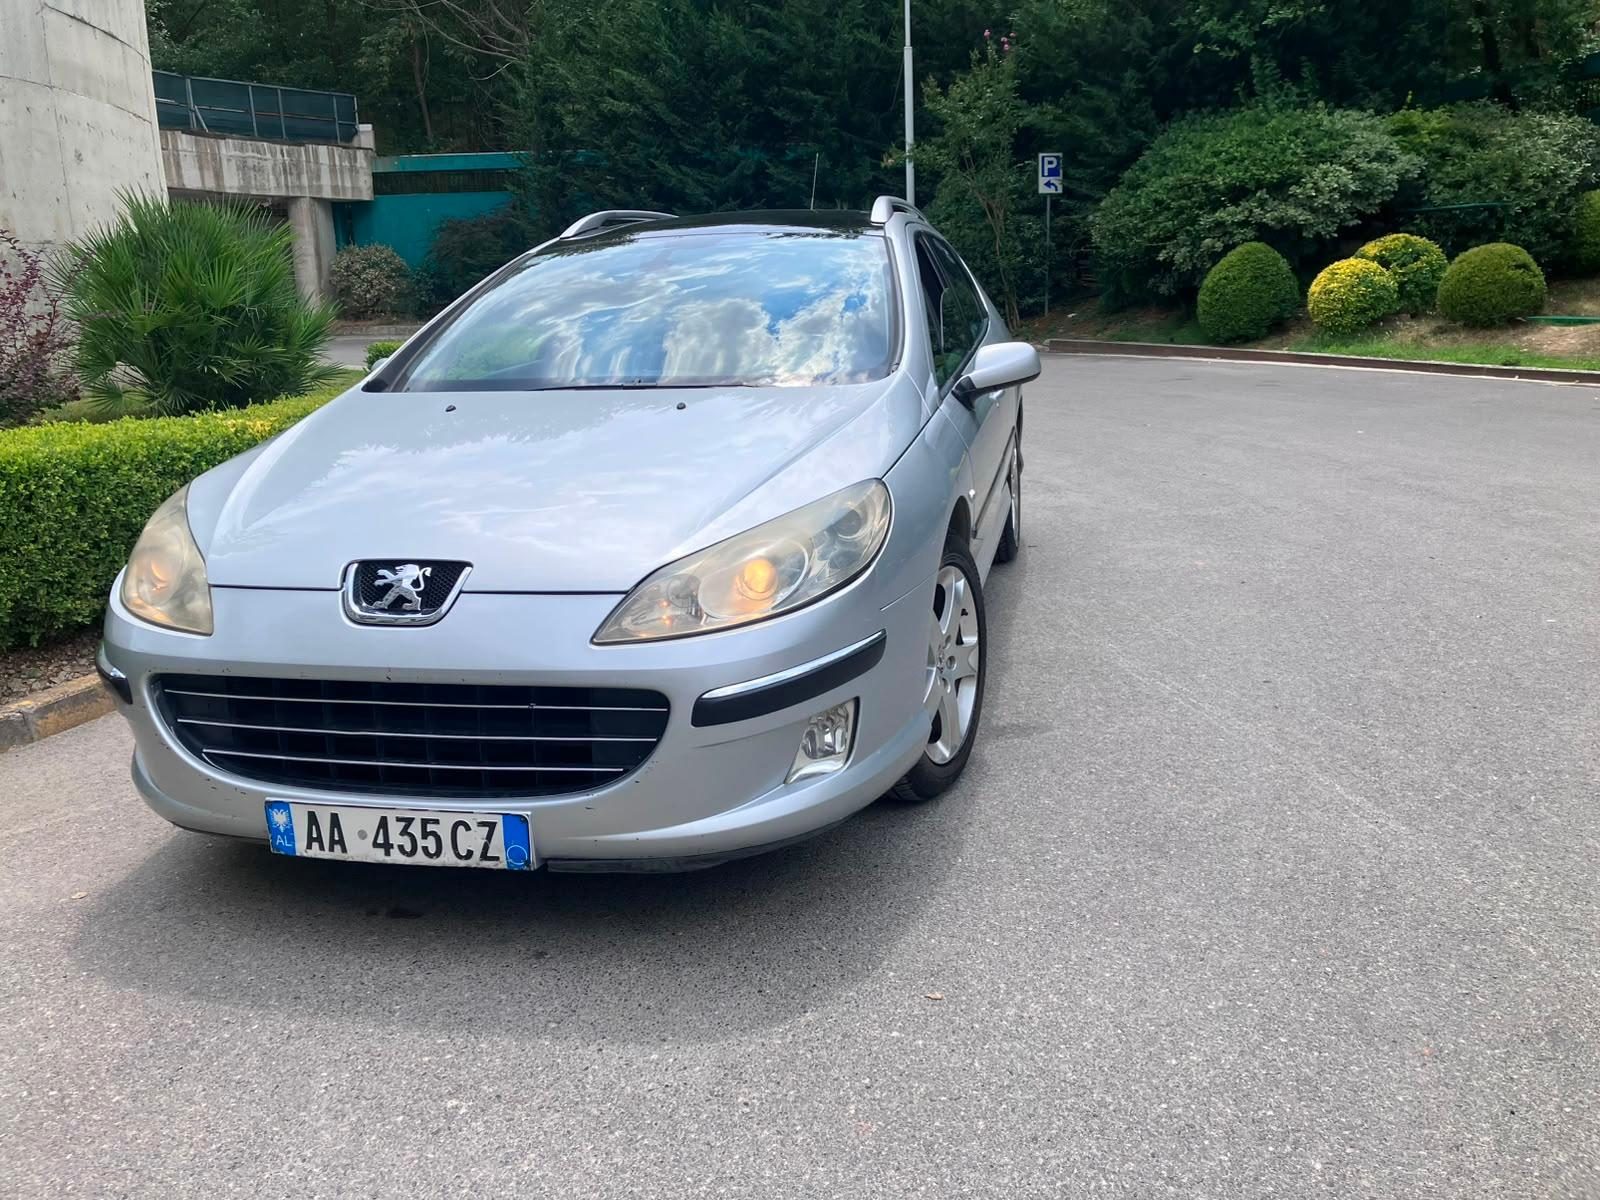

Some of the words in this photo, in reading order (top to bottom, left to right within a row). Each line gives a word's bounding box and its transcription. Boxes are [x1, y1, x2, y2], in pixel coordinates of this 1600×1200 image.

[1043, 156, 1058, 176] P
[275, 834, 293, 847] AL
[305, 810, 348, 854] AA
